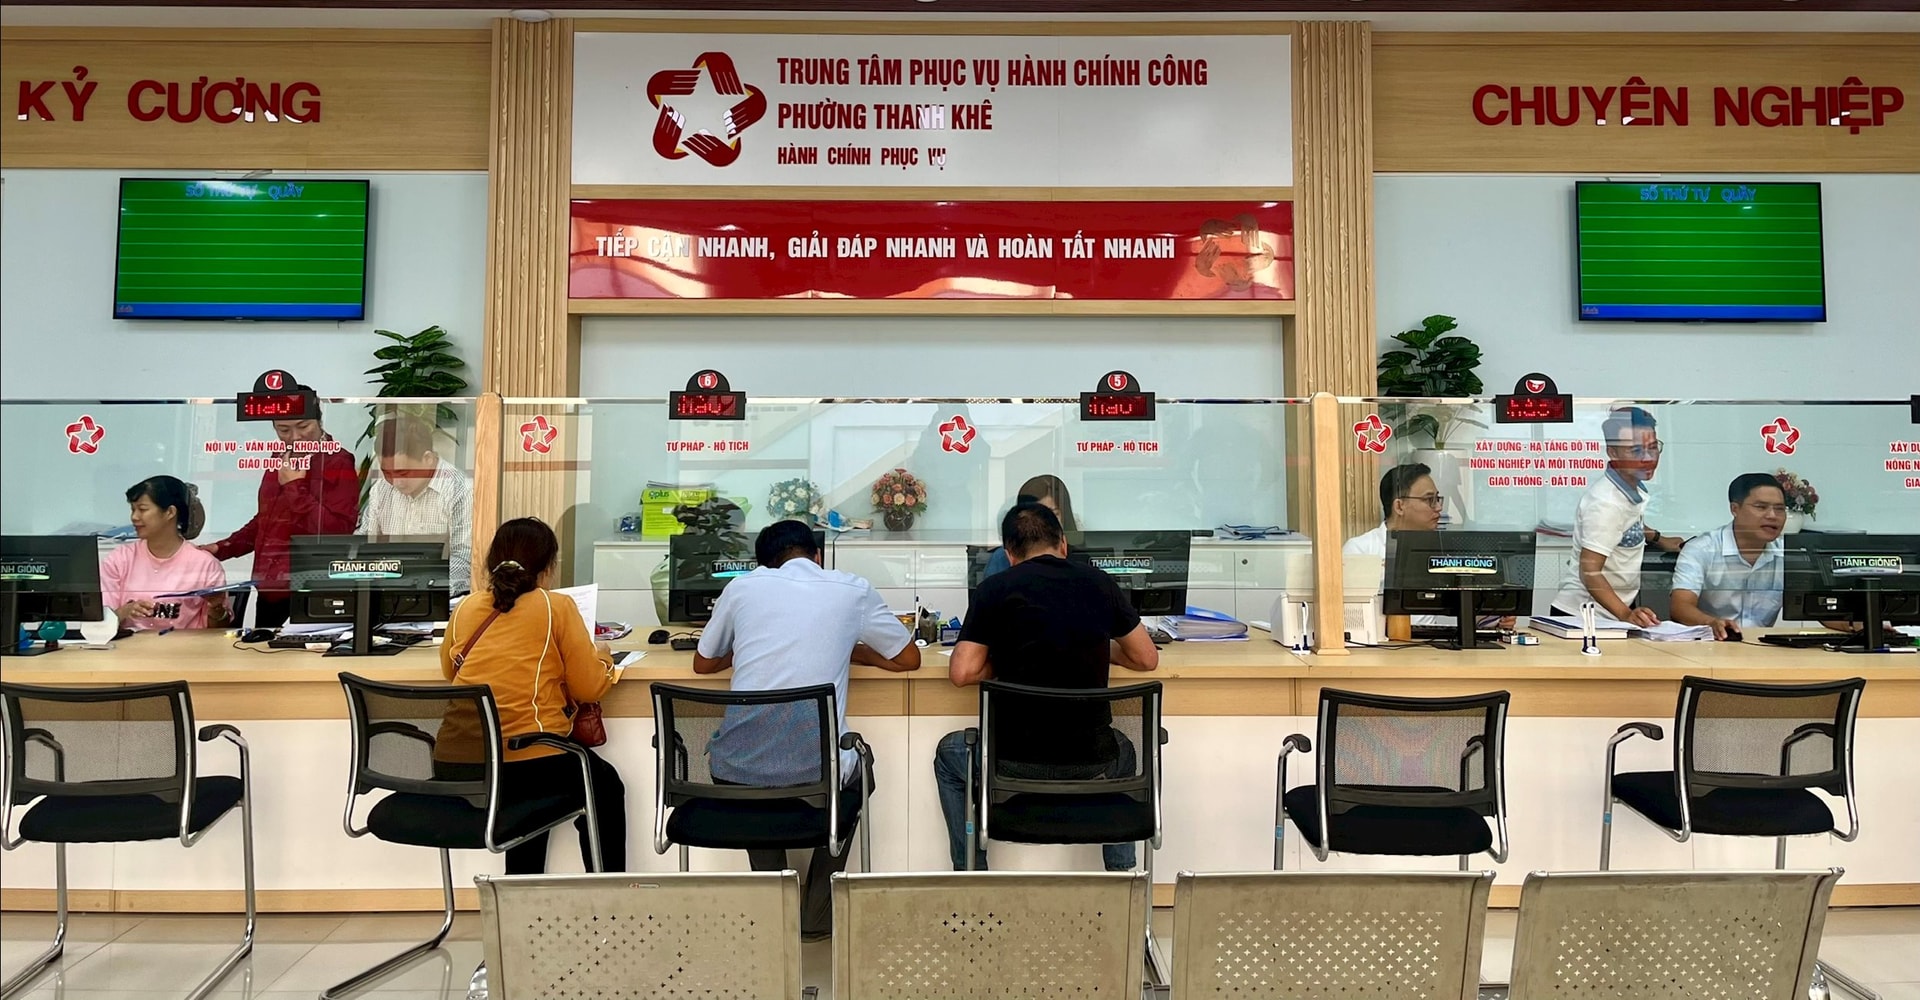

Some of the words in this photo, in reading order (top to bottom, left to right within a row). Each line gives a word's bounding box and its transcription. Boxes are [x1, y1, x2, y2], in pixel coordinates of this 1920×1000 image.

[777, 58, 850, 84] TRUNG
[857, 54, 902, 85] TÂM
[910, 59, 966, 92] PHỤC
[973, 59, 1000, 92] VỤ
[1008, 54, 1066, 86] HÀNH
[1074, 54, 1140, 86] CHÍNH
[1148, 54, 1208, 86] CÔNG
[17, 65, 98, 122] KỶ
[127, 76, 321, 124] CƯƠNG
[1472, 76, 1689, 127] CHUYÊN
[1713, 76, 1904, 135] NGHIỆP
[778, 98, 867, 130] PHƯỜNG
[874, 104, 945, 130] THANH
[951, 99, 993, 130] KHÊ
[778, 143, 818, 165] HÀNH
[828, 143, 871, 165] CHÍNH
[881, 148, 918, 170] PHỤC
[928, 148, 947, 170] VỤ
[1640, 185, 1659, 201] SỐ
[1663, 185, 1689, 201] THỨ
[1692, 187, 1711, 203] TỰ
[1721, 185, 1757, 204] QUẦY
[595, 228, 639, 258] TIẾP
[650, 233, 691, 263] CẬN
[698, 237, 775, 261] NHANH,
[788, 230, 828, 258] GIẢI
[837, 233, 878, 258] ĐÁP
[886, 237, 956, 258] NHANH
[965, 233, 989, 258] VÀ
[999, 233, 1053, 258] HOÀN
[1062, 230, 1096, 258] TẤT
[1104, 238, 1175, 258] NHANH
[205, 441, 221, 454] NỘI
[224, 441, 237, 454] VỤ
[245, 440, 264, 452] VĂN
[266, 440, 286, 452] HÓA
[294, 441, 319, 452] KHOA
[322, 441, 340, 454] HỌC
[667, 442, 679, 452] TƯ
[681, 440, 705, 452] PHÁP
[714, 441, 726, 454] HỘ
[729, 441, 749, 454] TỊCH
[1077, 442, 1089, 452] TƯ
[1091, 440, 1115, 452] PHÁP
[1123, 441, 1136, 454] HỘ
[1138, 441, 1158, 454] TỊCH
[1476, 441, 1493, 452] XÂY
[1497, 441, 1522, 454] DỰNG
[1530, 442, 1542, 455] HẠ
[1545, 440, 1568, 452] TẦNG
[1571, 440, 1583, 452] ĐÔ
[1586, 442, 1600, 455] THỊ
[1890, 441, 1908, 453] XÂY
[238, 457, 260, 470] GIÁO
[263, 459, 282, 472] DỤC
[290, 458, 297, 469] Y
[299, 455, 311, 469] TẾ
[1471, 457, 1496, 469] NÔNG
[1498, 457, 1531, 472] NGHIỆP
[1534, 457, 1546, 469] VÀ
[1548, 457, 1566, 469] MÔI
[1569, 457, 1604, 469] TRƯỜNG
[1886, 459, 1911, 471] NÔNG
[1489, 477, 1510, 487] GIAO
[1513, 475, 1543, 487] THÔNG
[1551, 475, 1569, 487] ĐẤT
[1571, 476, 1587, 487] ĐAI
